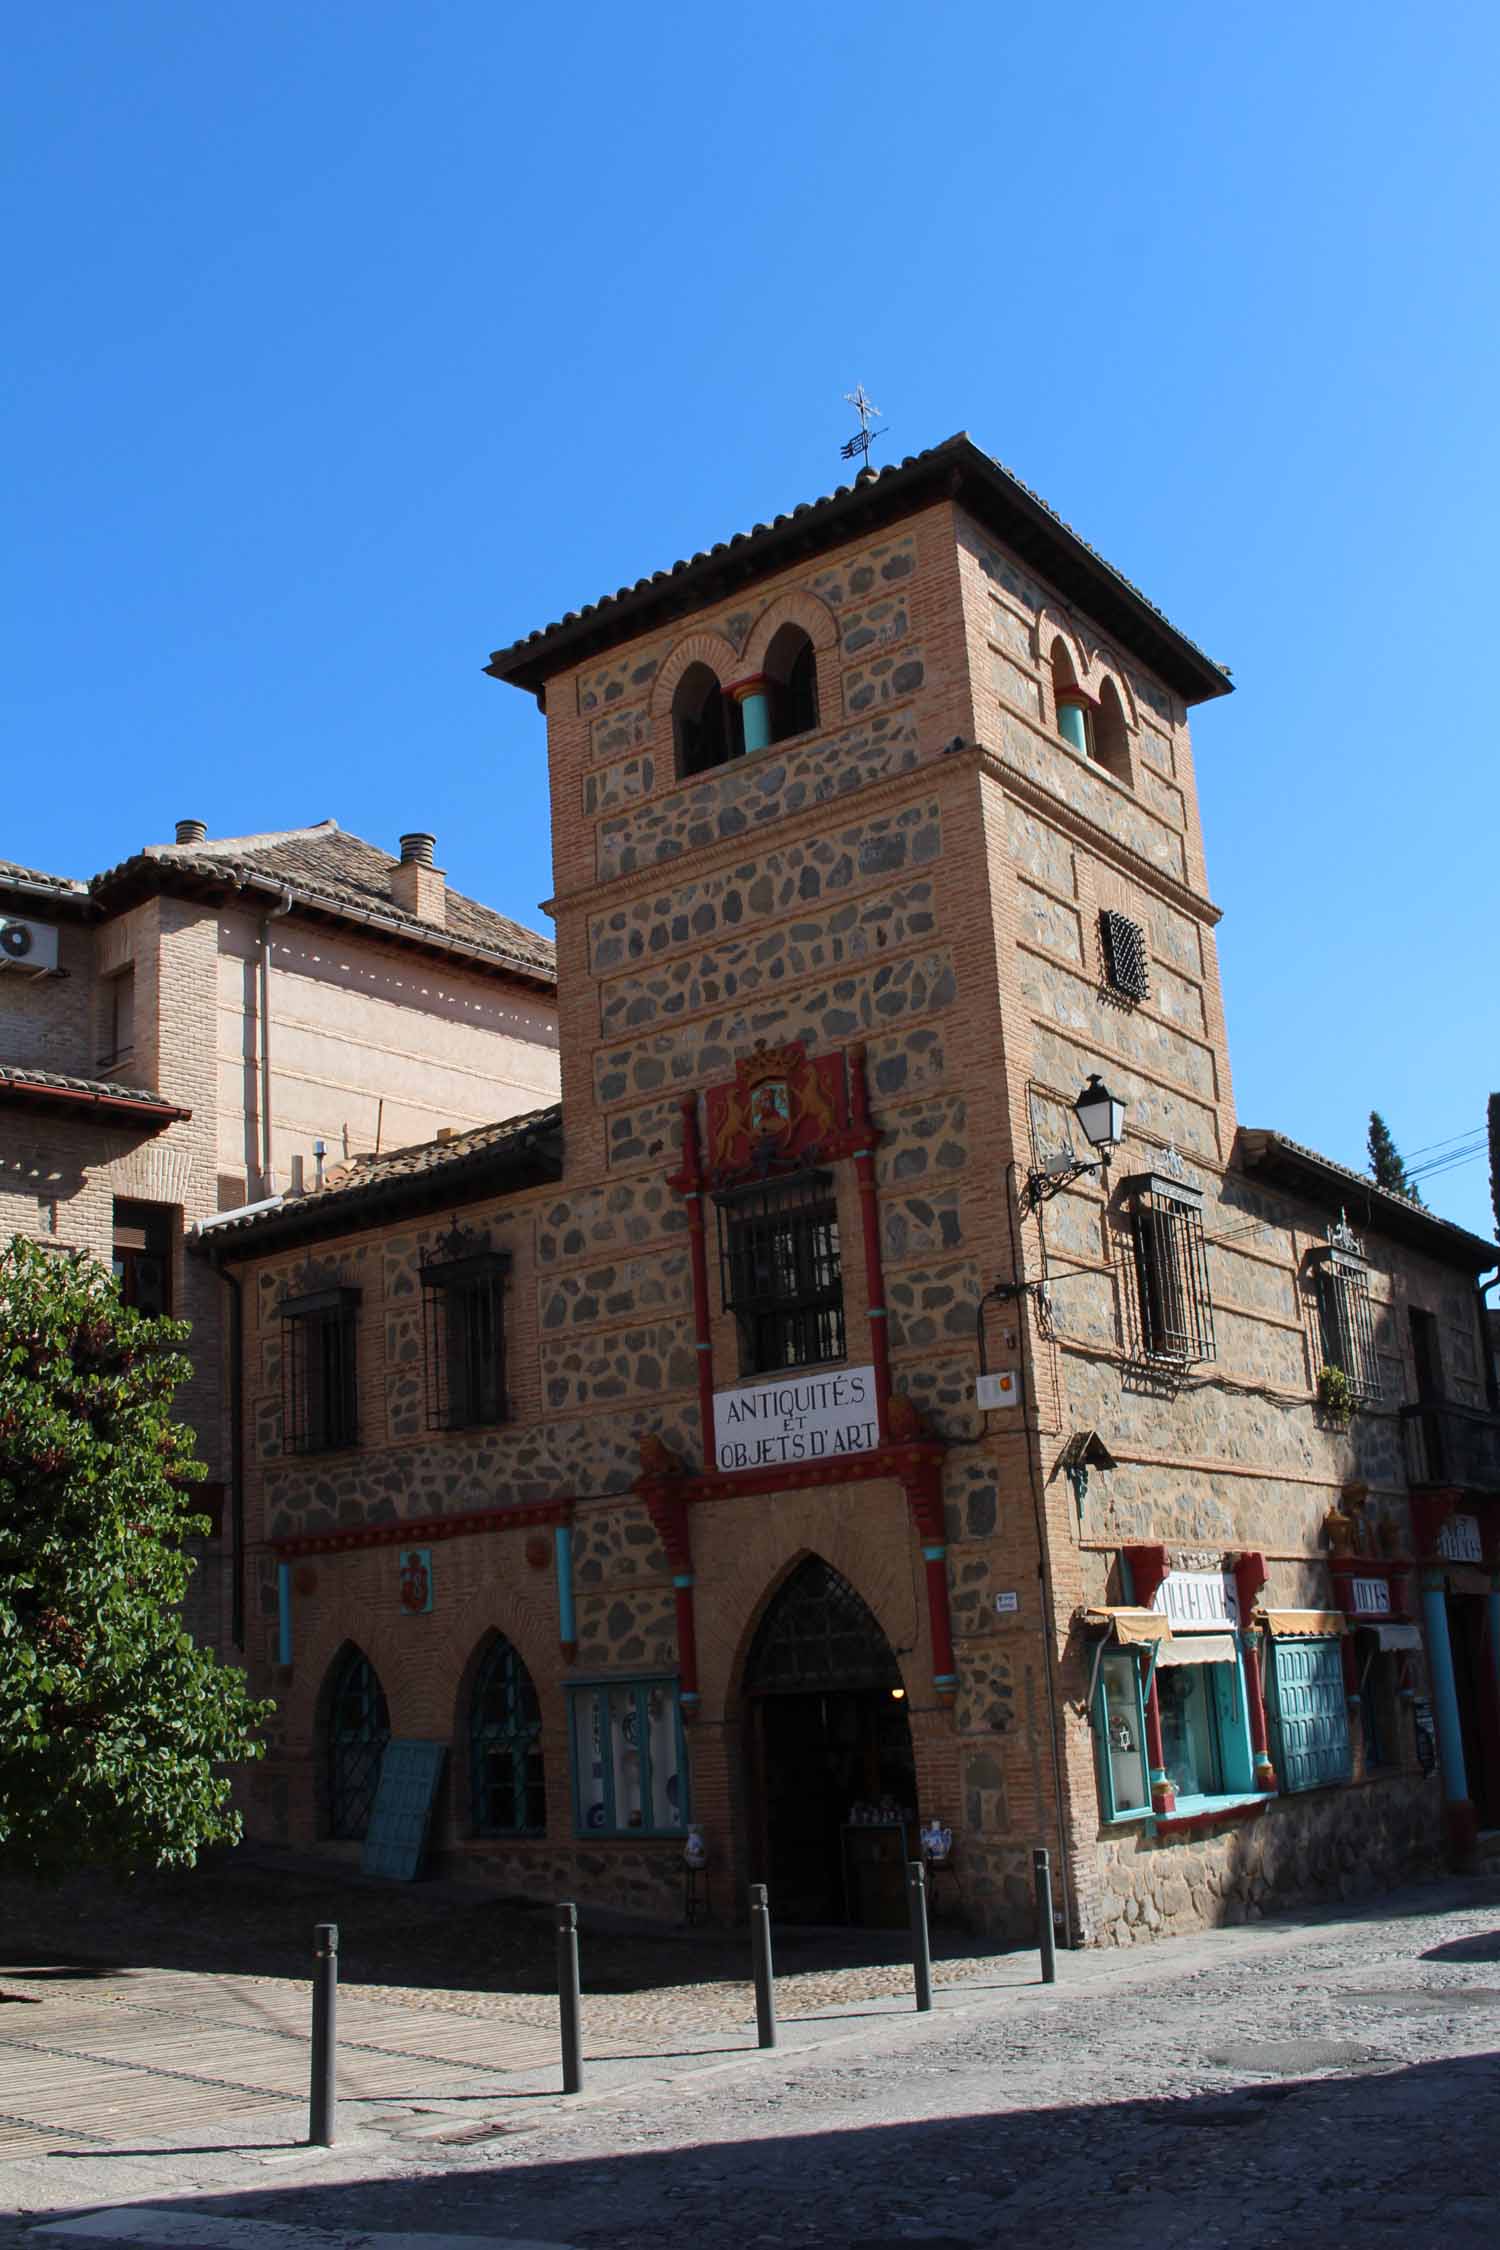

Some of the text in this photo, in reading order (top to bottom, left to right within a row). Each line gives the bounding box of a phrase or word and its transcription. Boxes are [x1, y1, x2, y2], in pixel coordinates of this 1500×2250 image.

[727, 1375, 865, 1424] ANTIQUITÉS
[783, 1416, 808, 1431] ET
[720, 1421, 876, 1469] OBJETS D'ART
